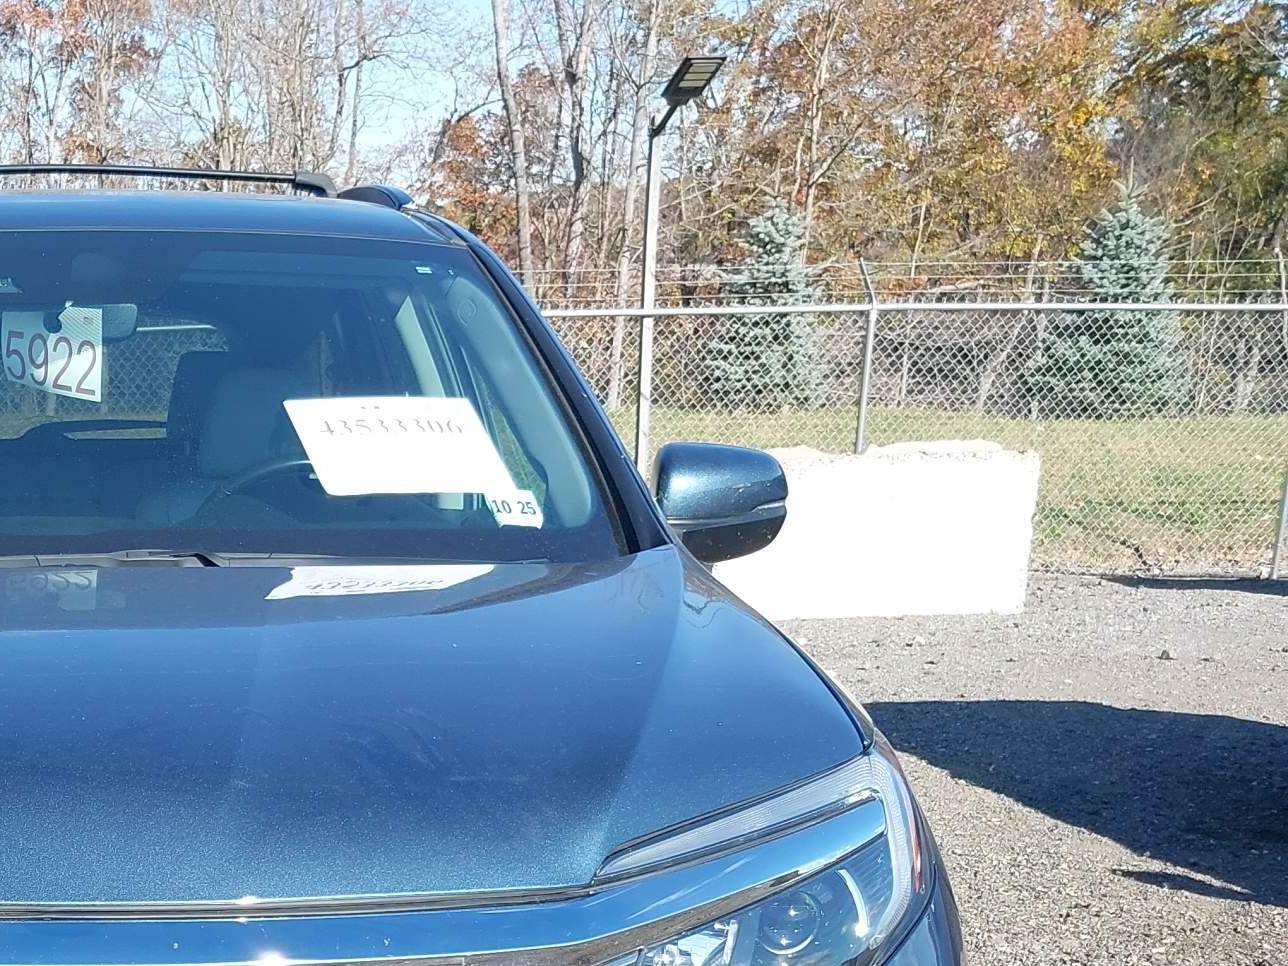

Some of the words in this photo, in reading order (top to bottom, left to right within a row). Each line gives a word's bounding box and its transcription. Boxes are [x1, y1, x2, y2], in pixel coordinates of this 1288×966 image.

[5, 330, 97, 397] 5922
[492, 500, 512, 514] 10
[516, 501, 537, 515] 25
